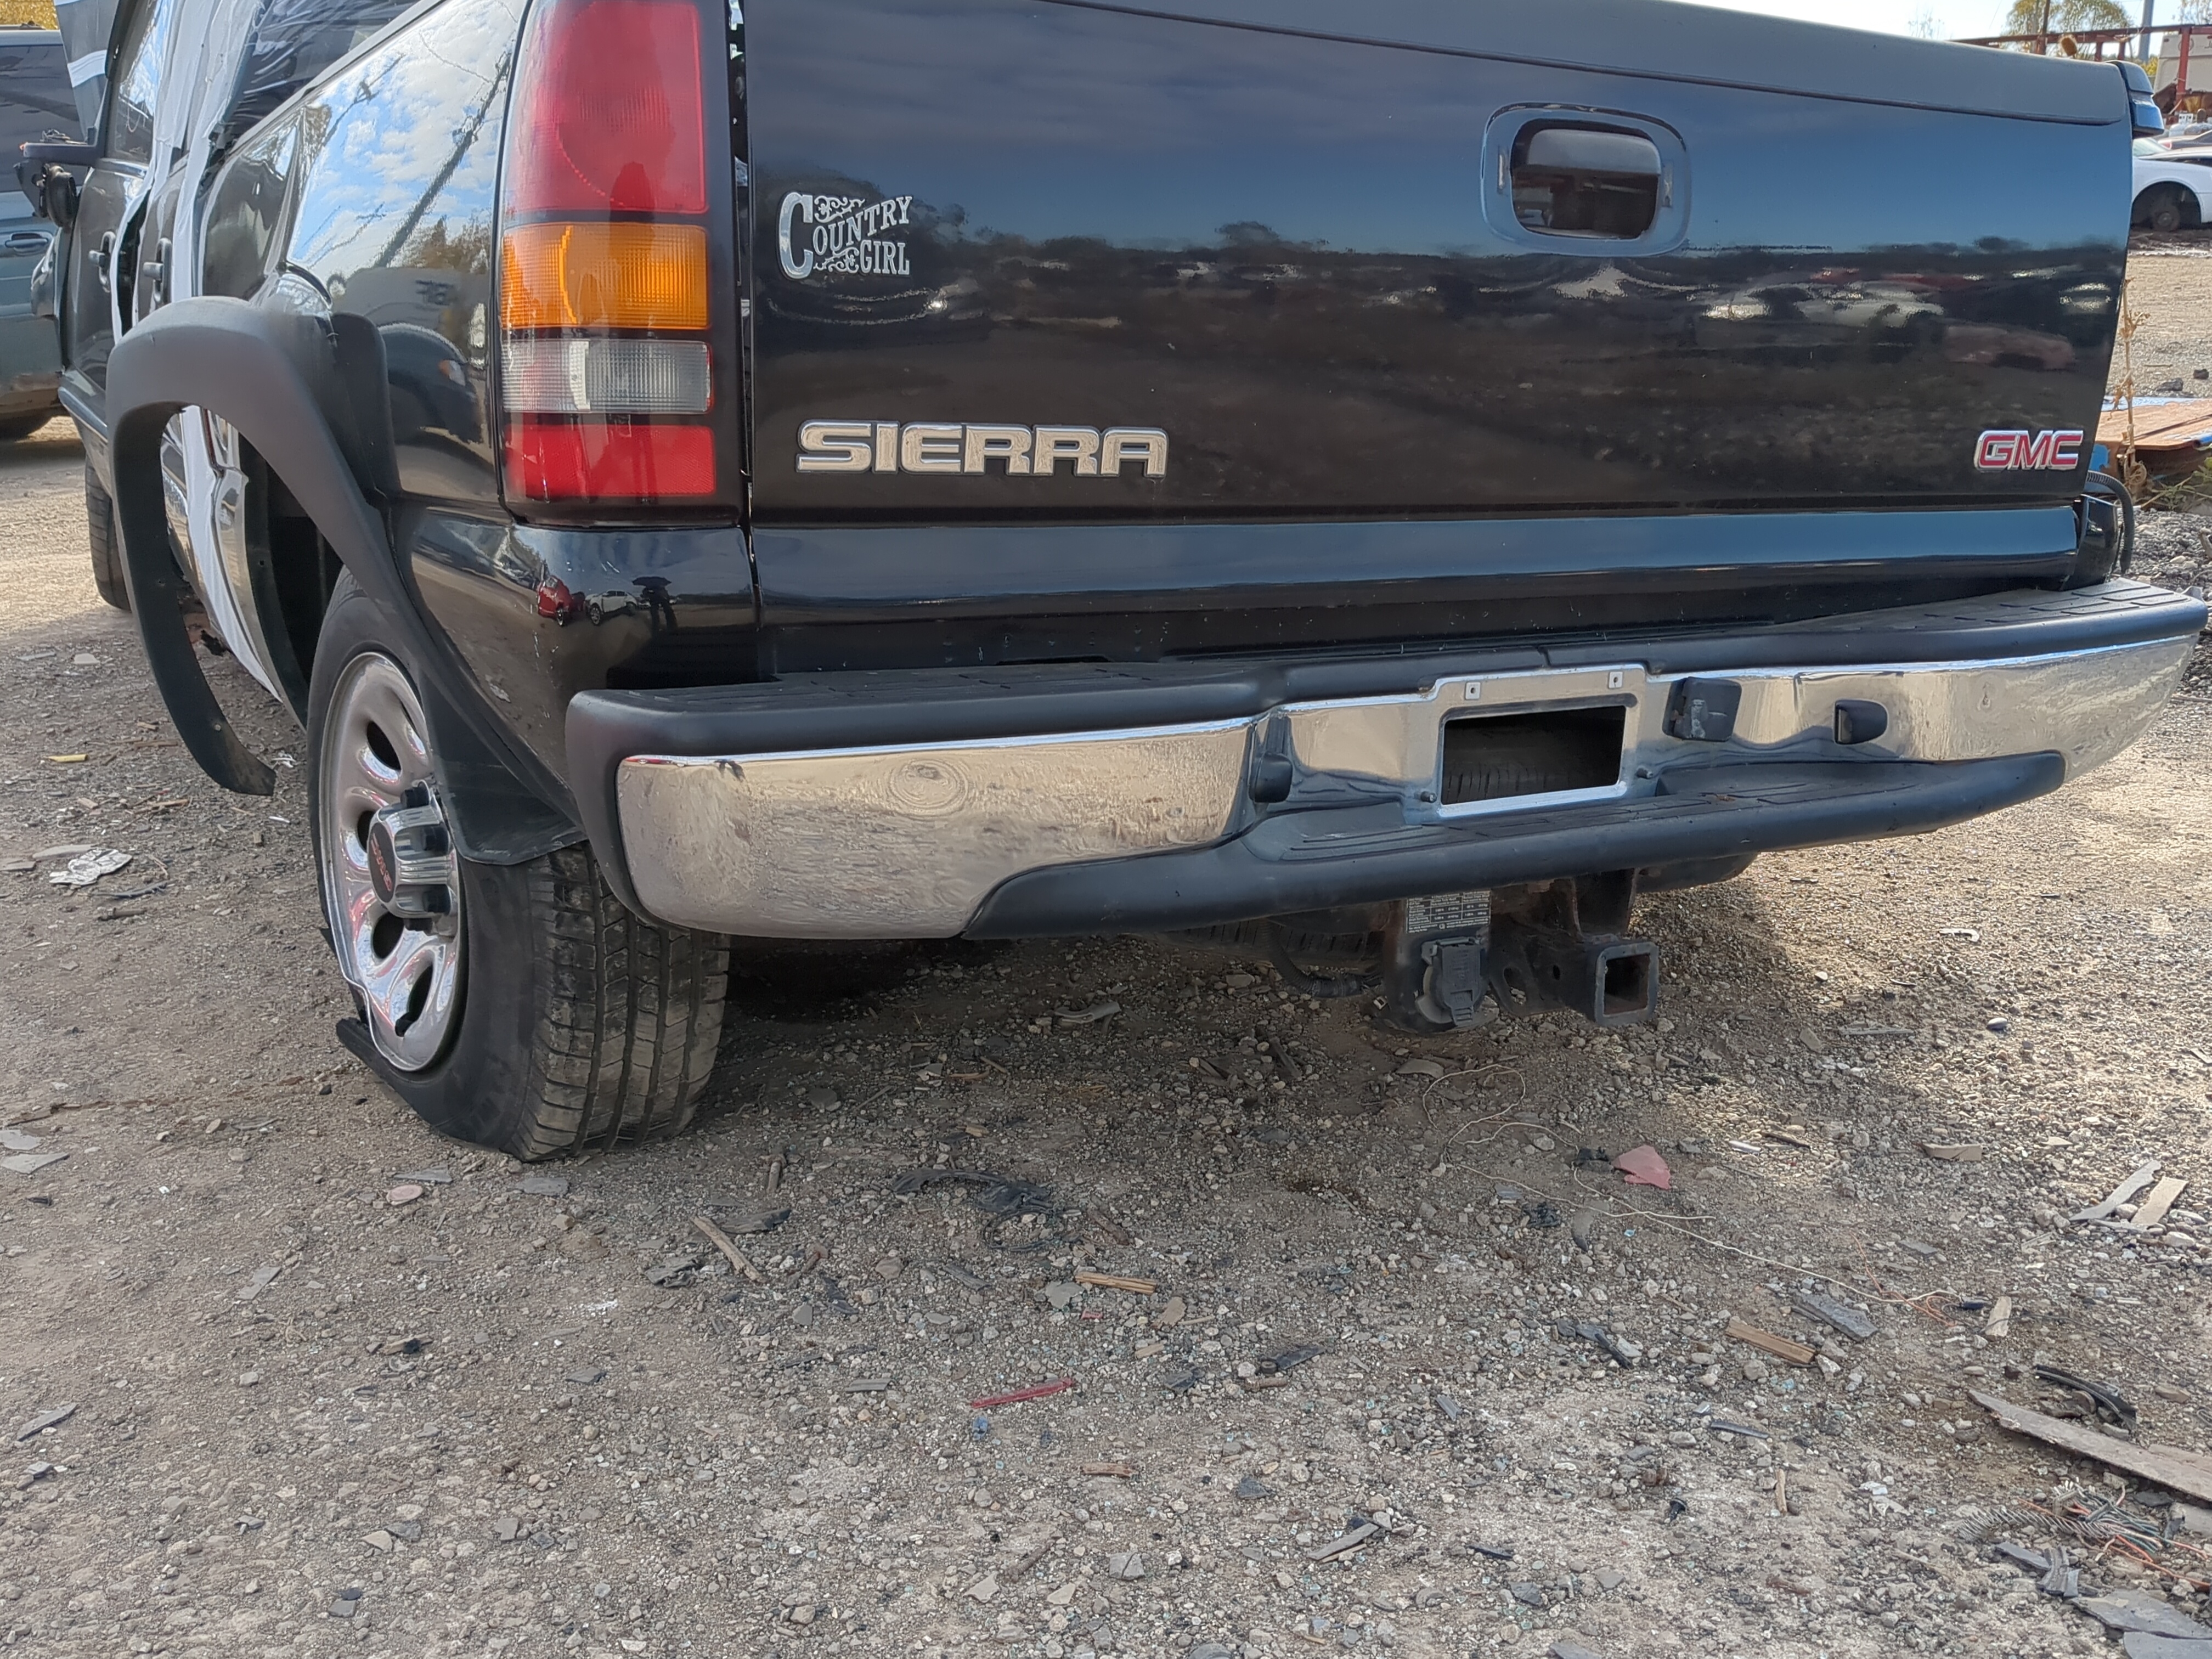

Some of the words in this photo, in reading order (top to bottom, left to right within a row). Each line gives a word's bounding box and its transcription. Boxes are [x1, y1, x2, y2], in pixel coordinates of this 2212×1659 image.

[779, 191, 913, 279] COUNTRY
[860, 240, 910, 275] GIRL
[797, 419, 1169, 478] SIERRA
[1974, 430, 2084, 472] GMC
